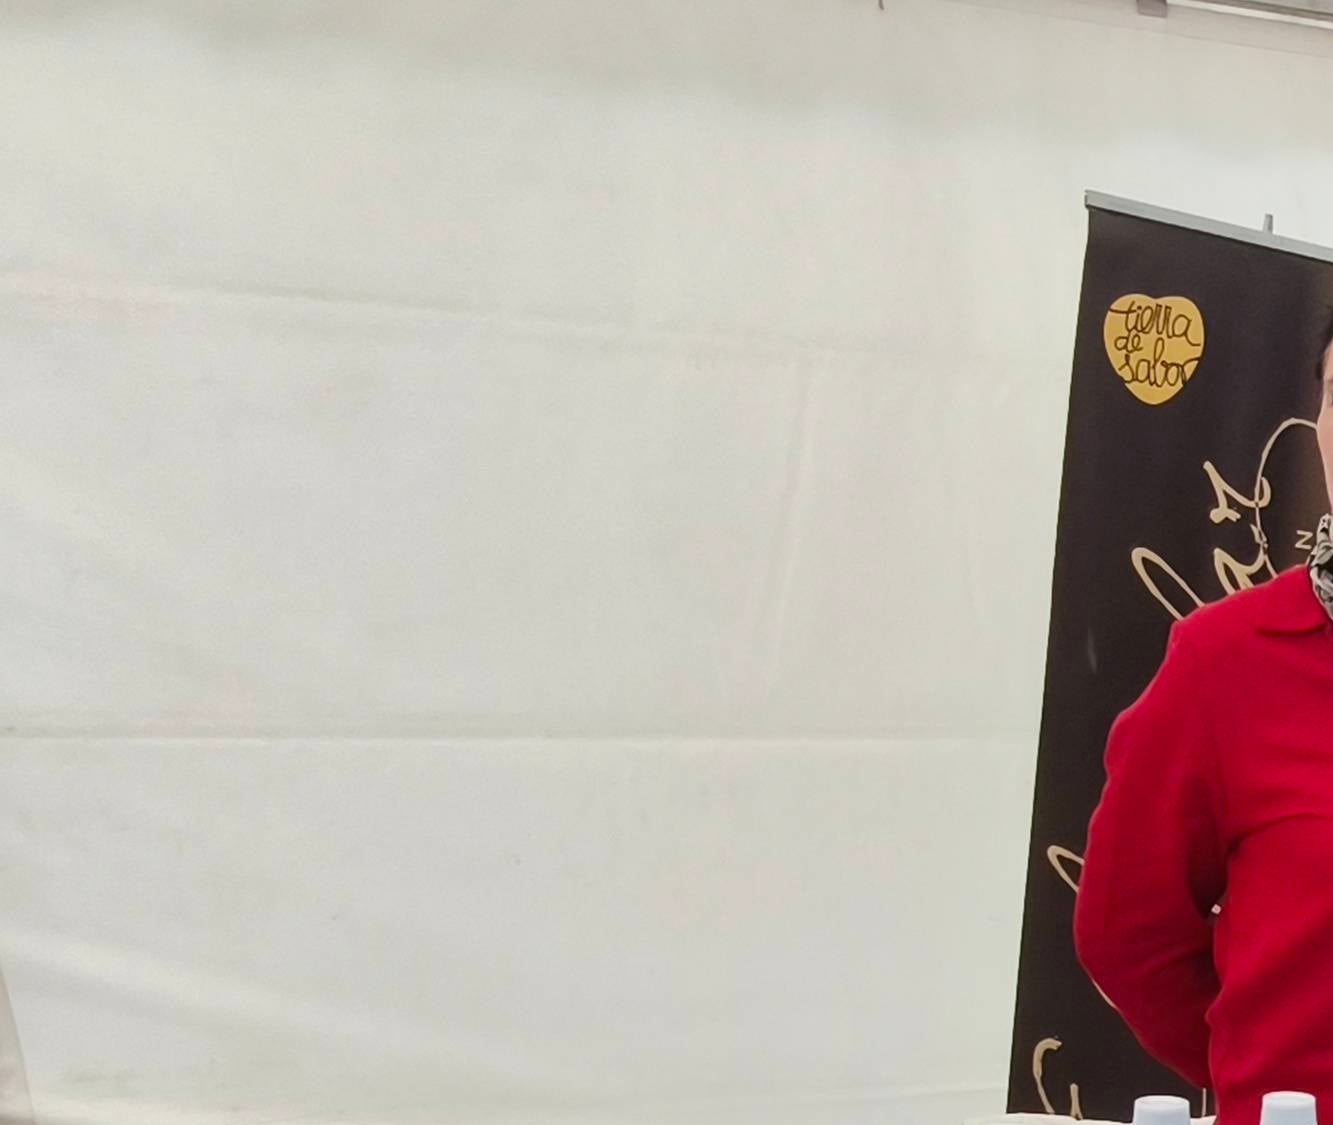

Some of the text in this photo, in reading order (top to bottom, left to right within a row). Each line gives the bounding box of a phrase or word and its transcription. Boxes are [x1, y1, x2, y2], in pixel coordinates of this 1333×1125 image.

[1109, 301, 1201, 346] tierra
[1114, 333, 1143, 353] de
[1118, 338, 1201, 388] sabor
